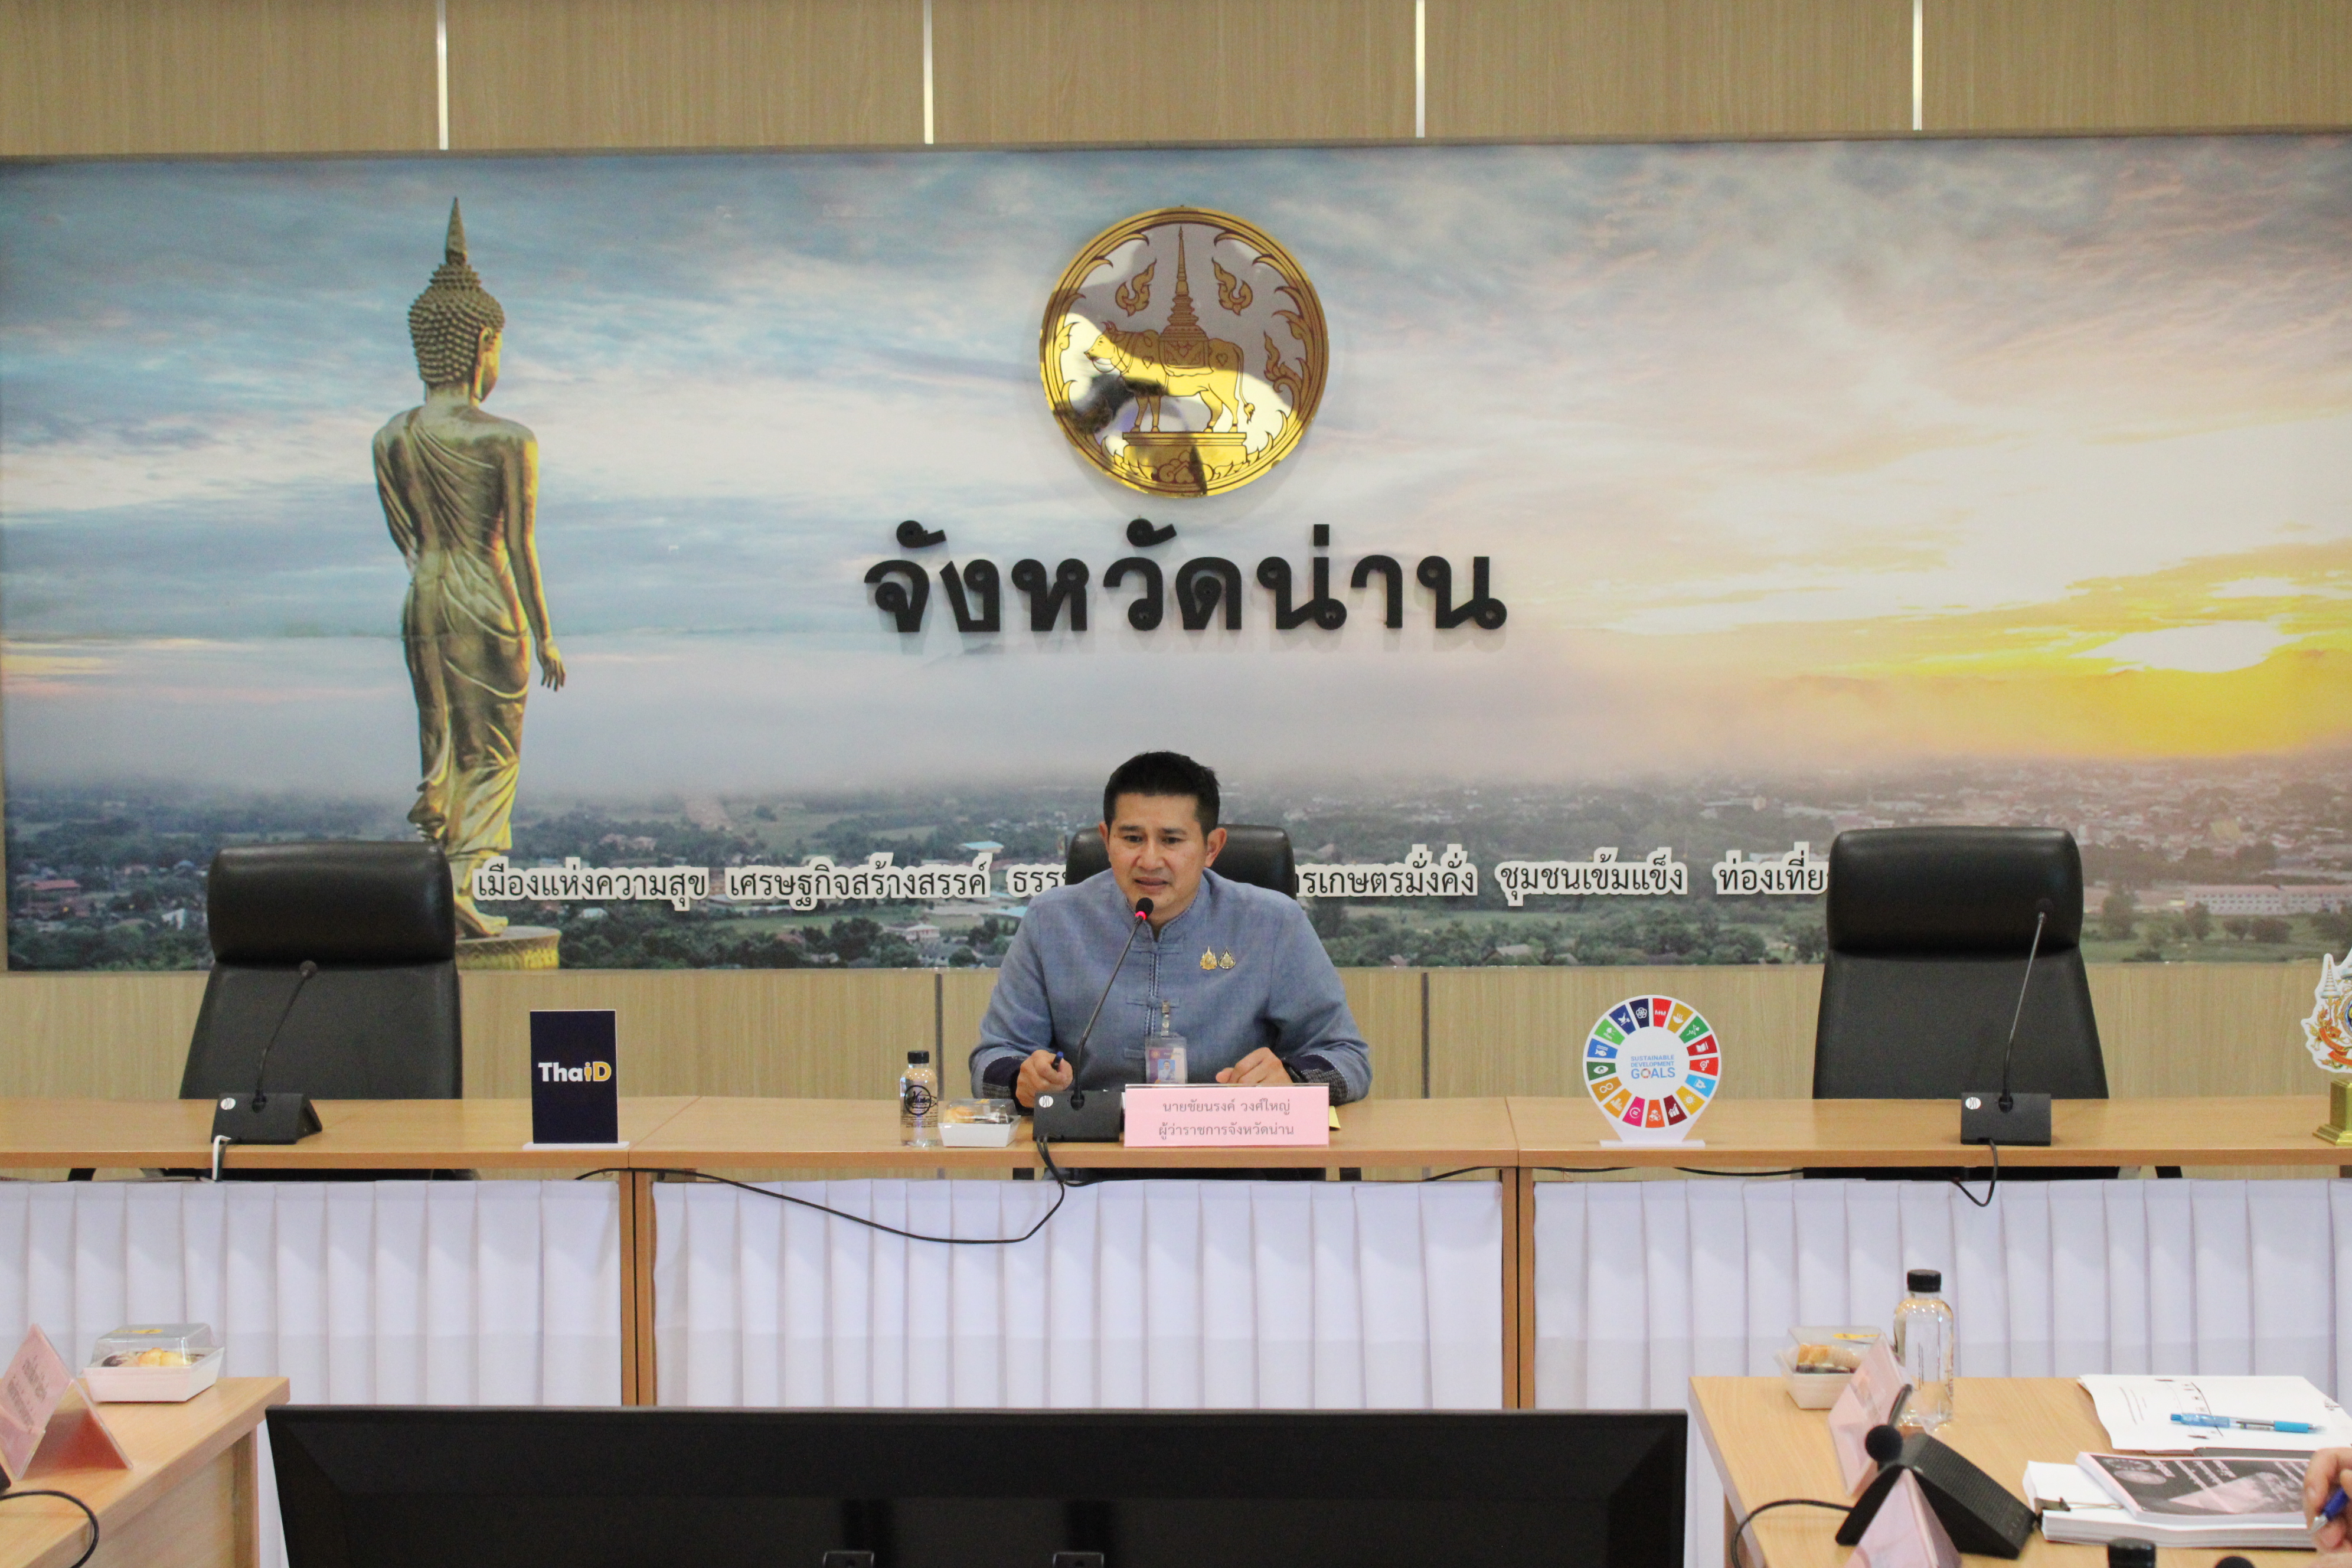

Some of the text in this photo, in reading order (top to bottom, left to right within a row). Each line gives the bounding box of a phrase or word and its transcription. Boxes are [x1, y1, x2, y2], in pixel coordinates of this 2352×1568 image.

[864, 520, 1507, 632] จังหวัดน่าน
[478, 863, 705, 907] เมืองแห่งความสุข
[730, 860, 986, 907] เศรษฐกิจสร้างสรรค์
[1500, 854, 1683, 901] ชุมชนเข้มแข็ง
[1719, 850, 1828, 890] ท่องเที่ย
[538, 1061, 612, 1082] ThaiD
[1631, 1067, 1675, 1079] GOALS
[1162, 1097, 1290, 1115] นายชัยนรงค์ วงศ์ใหญ่
[1159, 1122, 1294, 1140] ผู้ว่าราชการจังหวัดน่าน
